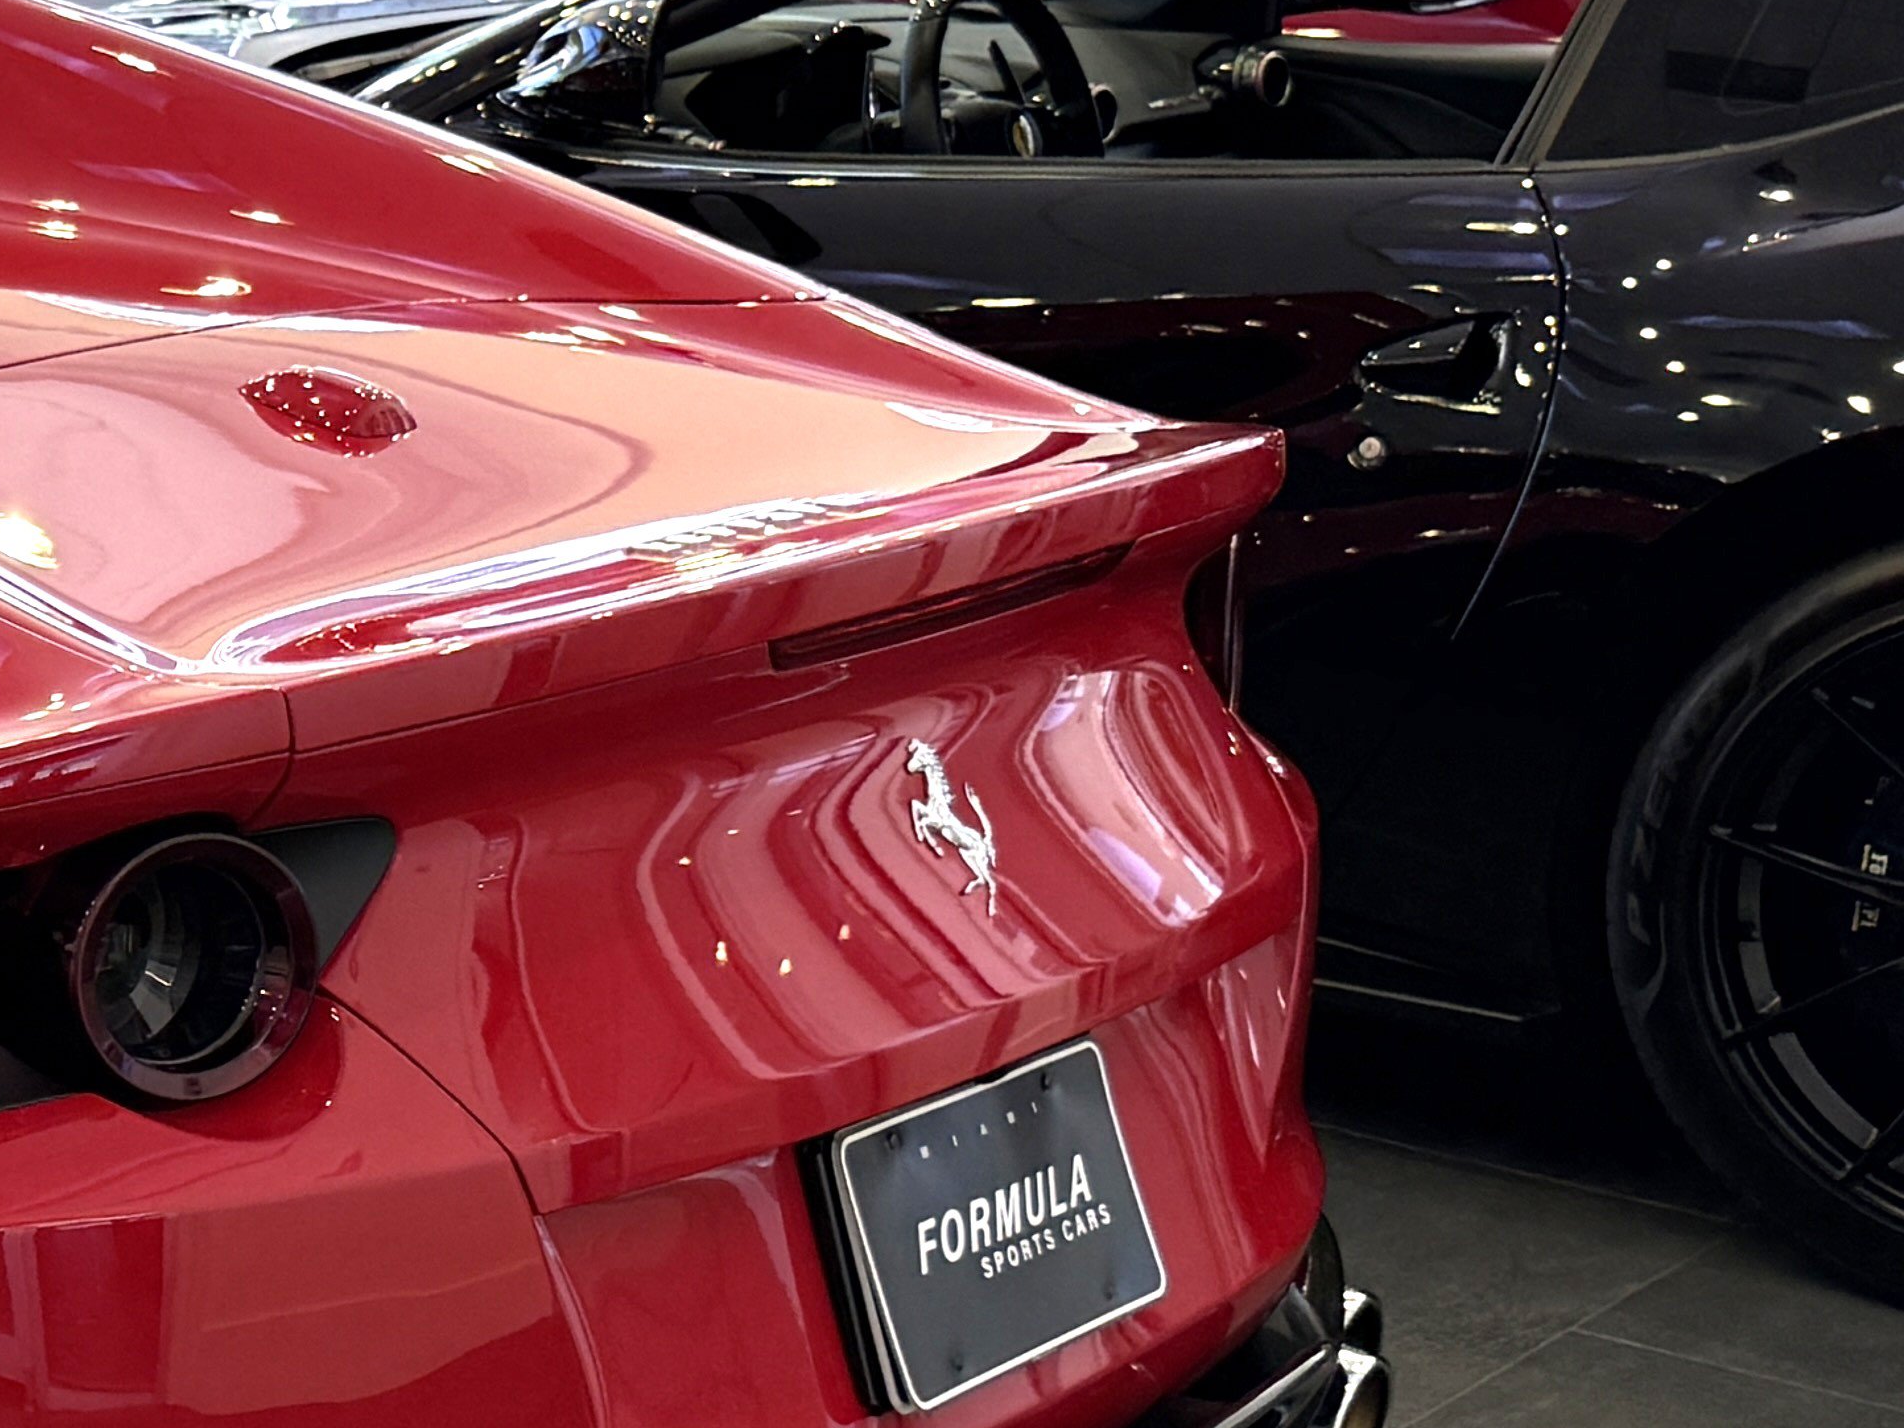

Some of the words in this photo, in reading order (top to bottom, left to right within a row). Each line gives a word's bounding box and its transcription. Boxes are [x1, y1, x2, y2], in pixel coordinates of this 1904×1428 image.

[918, 1100, 1039, 1160] MIAMI
[915, 1152, 1095, 1277] FORMULA
[980, 1225, 1057, 1280] SPORTS
[1060, 1202, 1113, 1243] CARS
